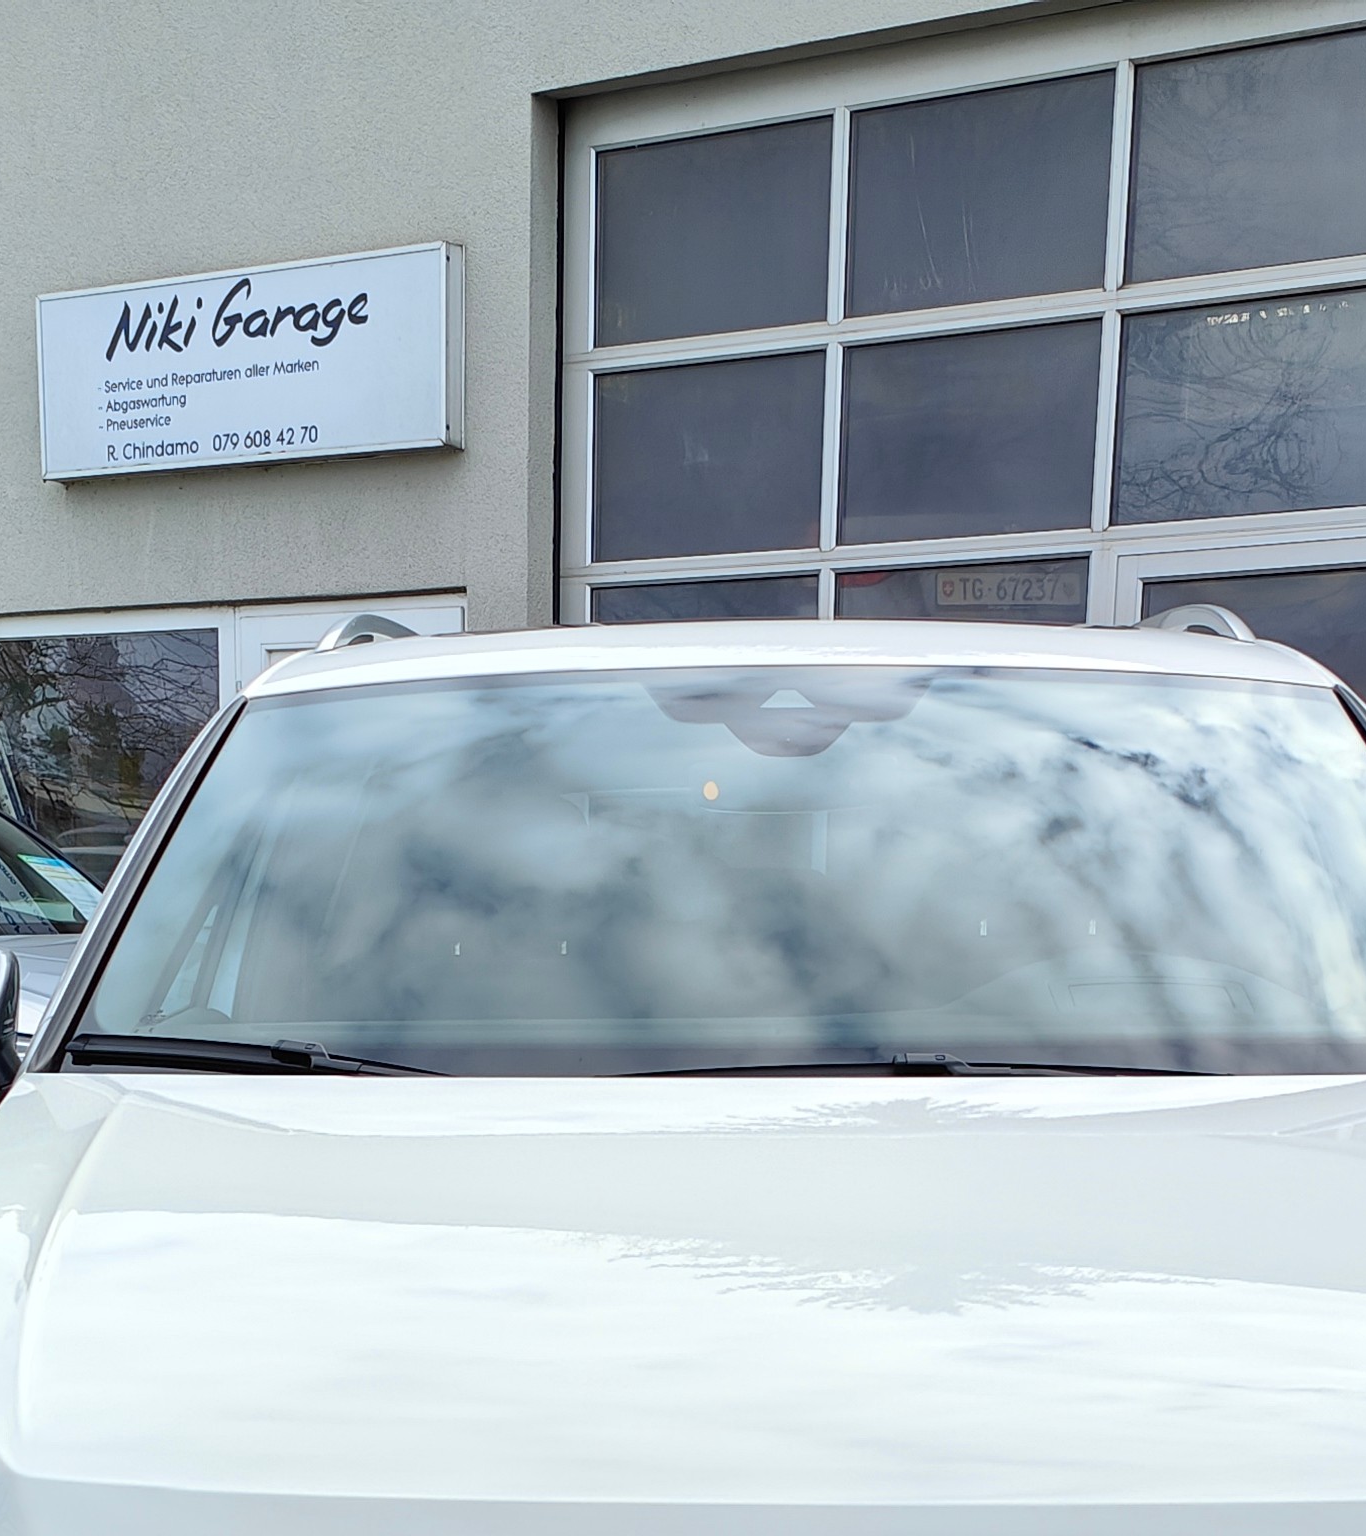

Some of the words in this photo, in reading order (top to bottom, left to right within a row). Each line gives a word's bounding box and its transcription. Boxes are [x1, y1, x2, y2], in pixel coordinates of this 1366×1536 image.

[106, 295, 202, 362] Niki
[212, 278, 368, 347] Garage
[104, 378, 143, 394] Service
[146, 374, 168, 389] und
[171, 368, 241, 388] Reparaturen
[245, 363, 270, 378] aller
[273, 359, 319, 375] Marken
[106, 394, 186, 414] Abgaswartung
[106, 414, 171, 431] Pneuservice
[123, 440, 199, 460] Chindamo
[212, 433, 240, 452] 079
[244, 429, 271, 449] 608
[276, 427, 295, 446] 42
[300, 425, 318, 444] 70
